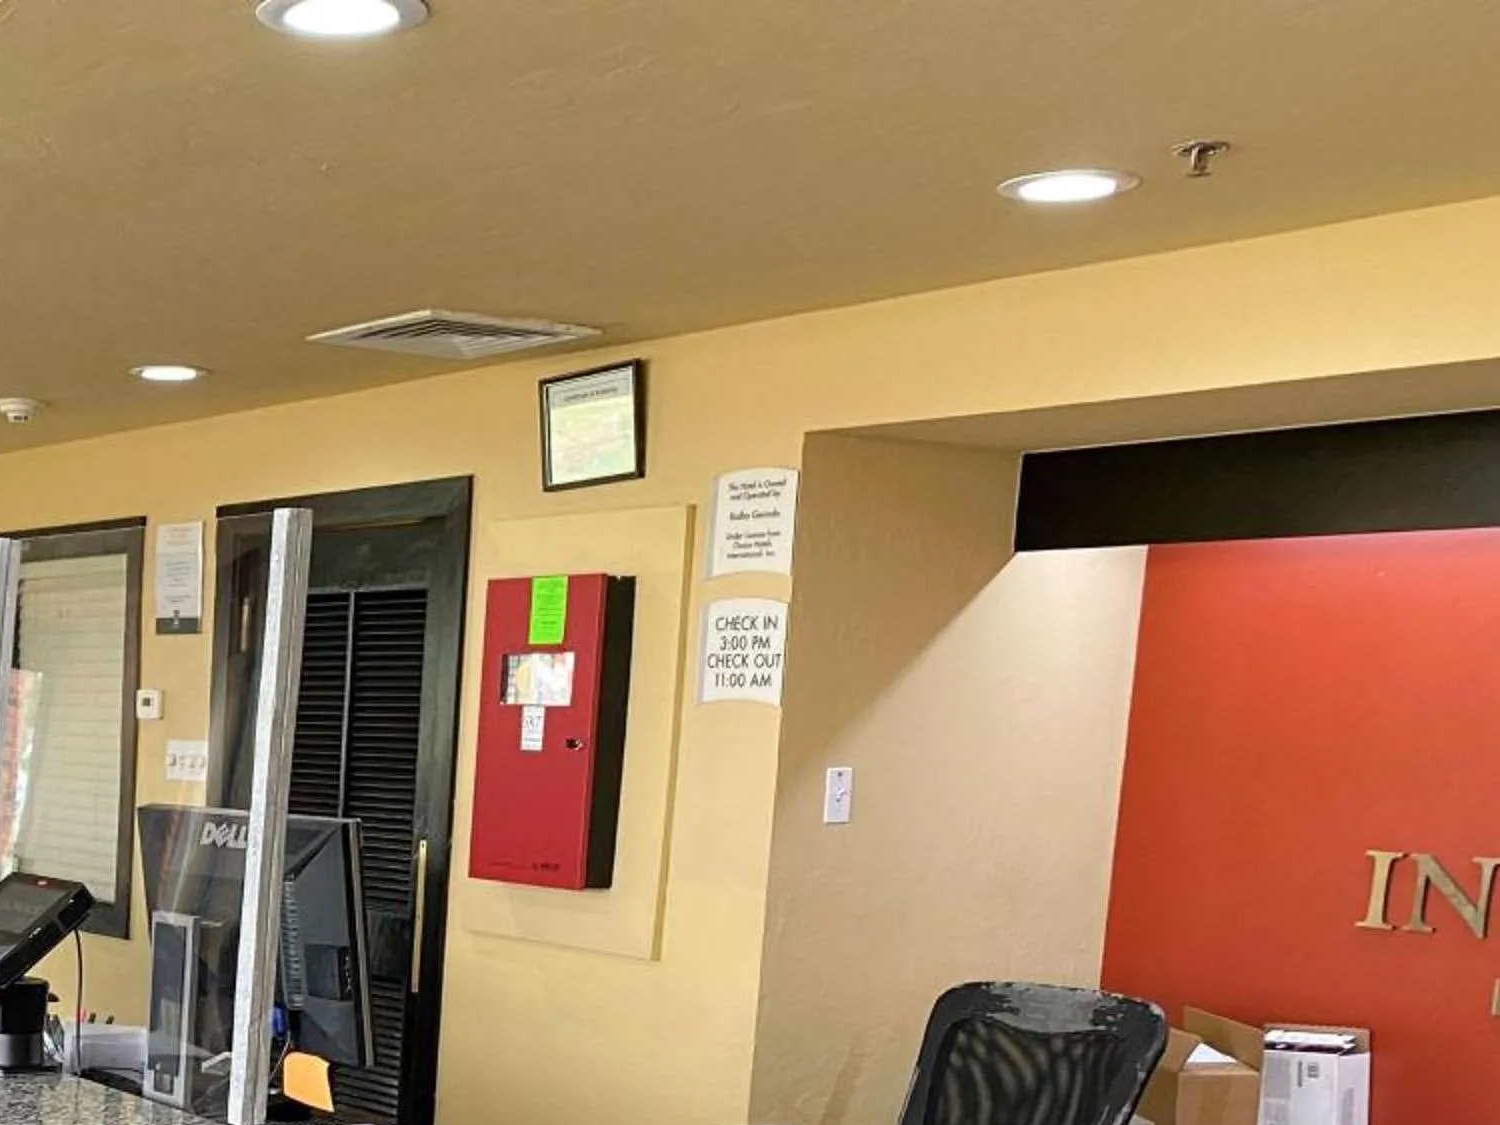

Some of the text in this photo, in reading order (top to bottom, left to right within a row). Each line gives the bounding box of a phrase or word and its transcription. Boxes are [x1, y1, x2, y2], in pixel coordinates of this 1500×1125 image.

[715, 614, 779, 631] CHECK IN
[719, 635, 771, 651] 3:00 PM
[706, 653, 782, 669] CHECK OUT
[714, 672, 772, 688] 11:00 AM
[200, 821, 247, 849] DELL
